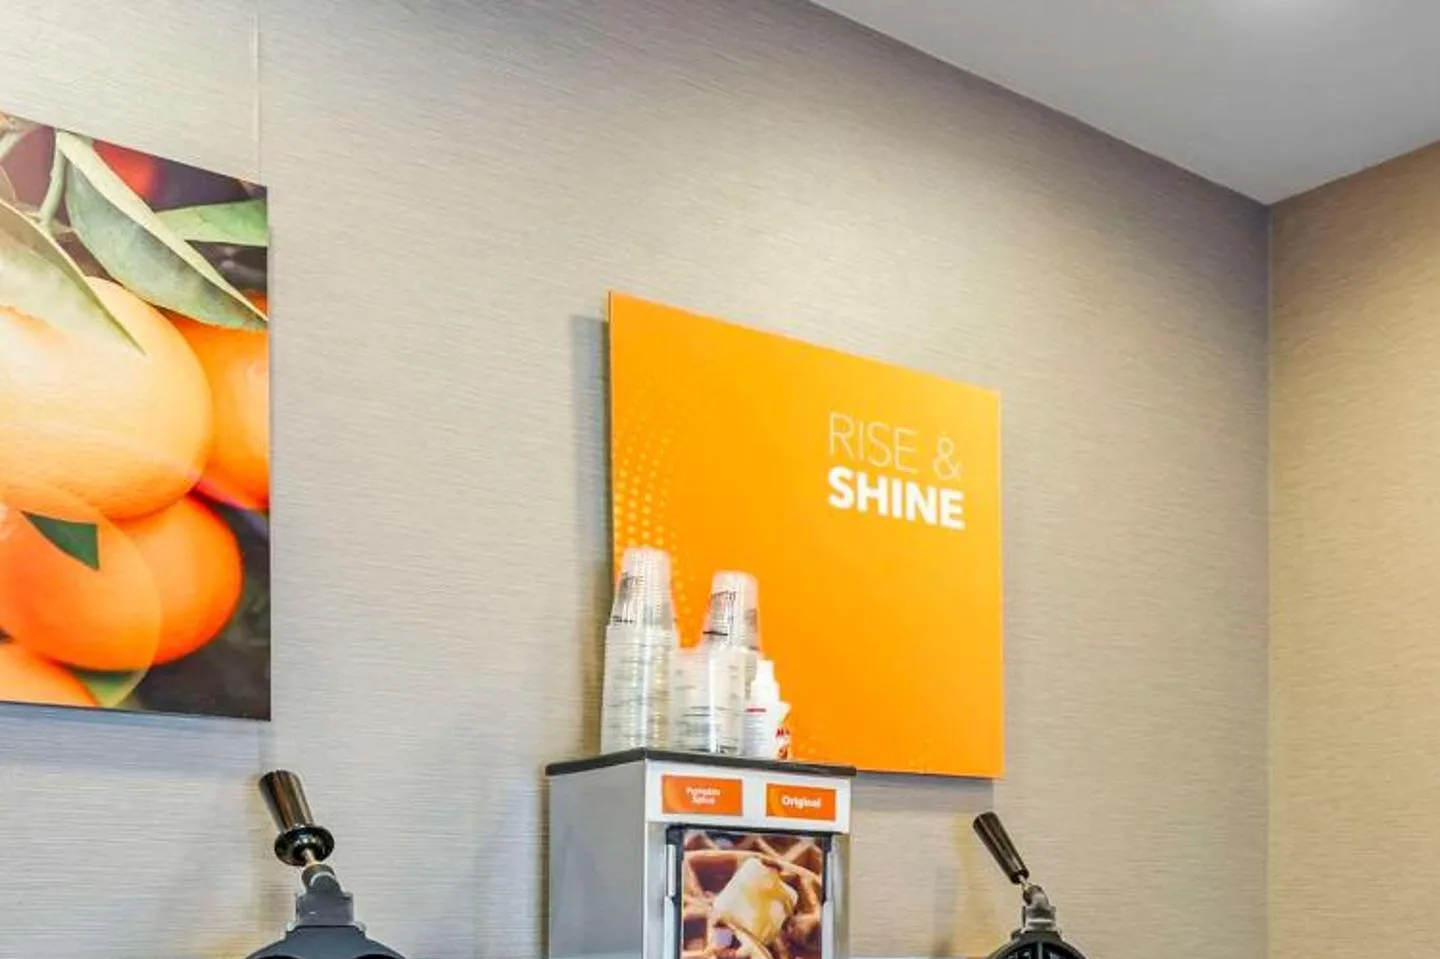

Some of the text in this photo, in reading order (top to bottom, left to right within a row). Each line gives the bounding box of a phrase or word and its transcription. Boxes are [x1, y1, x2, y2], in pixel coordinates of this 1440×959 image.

[828, 411, 964, 481] RISE &
[827, 465, 967, 531] SHINE
[781, 795, 822, 810] Original
